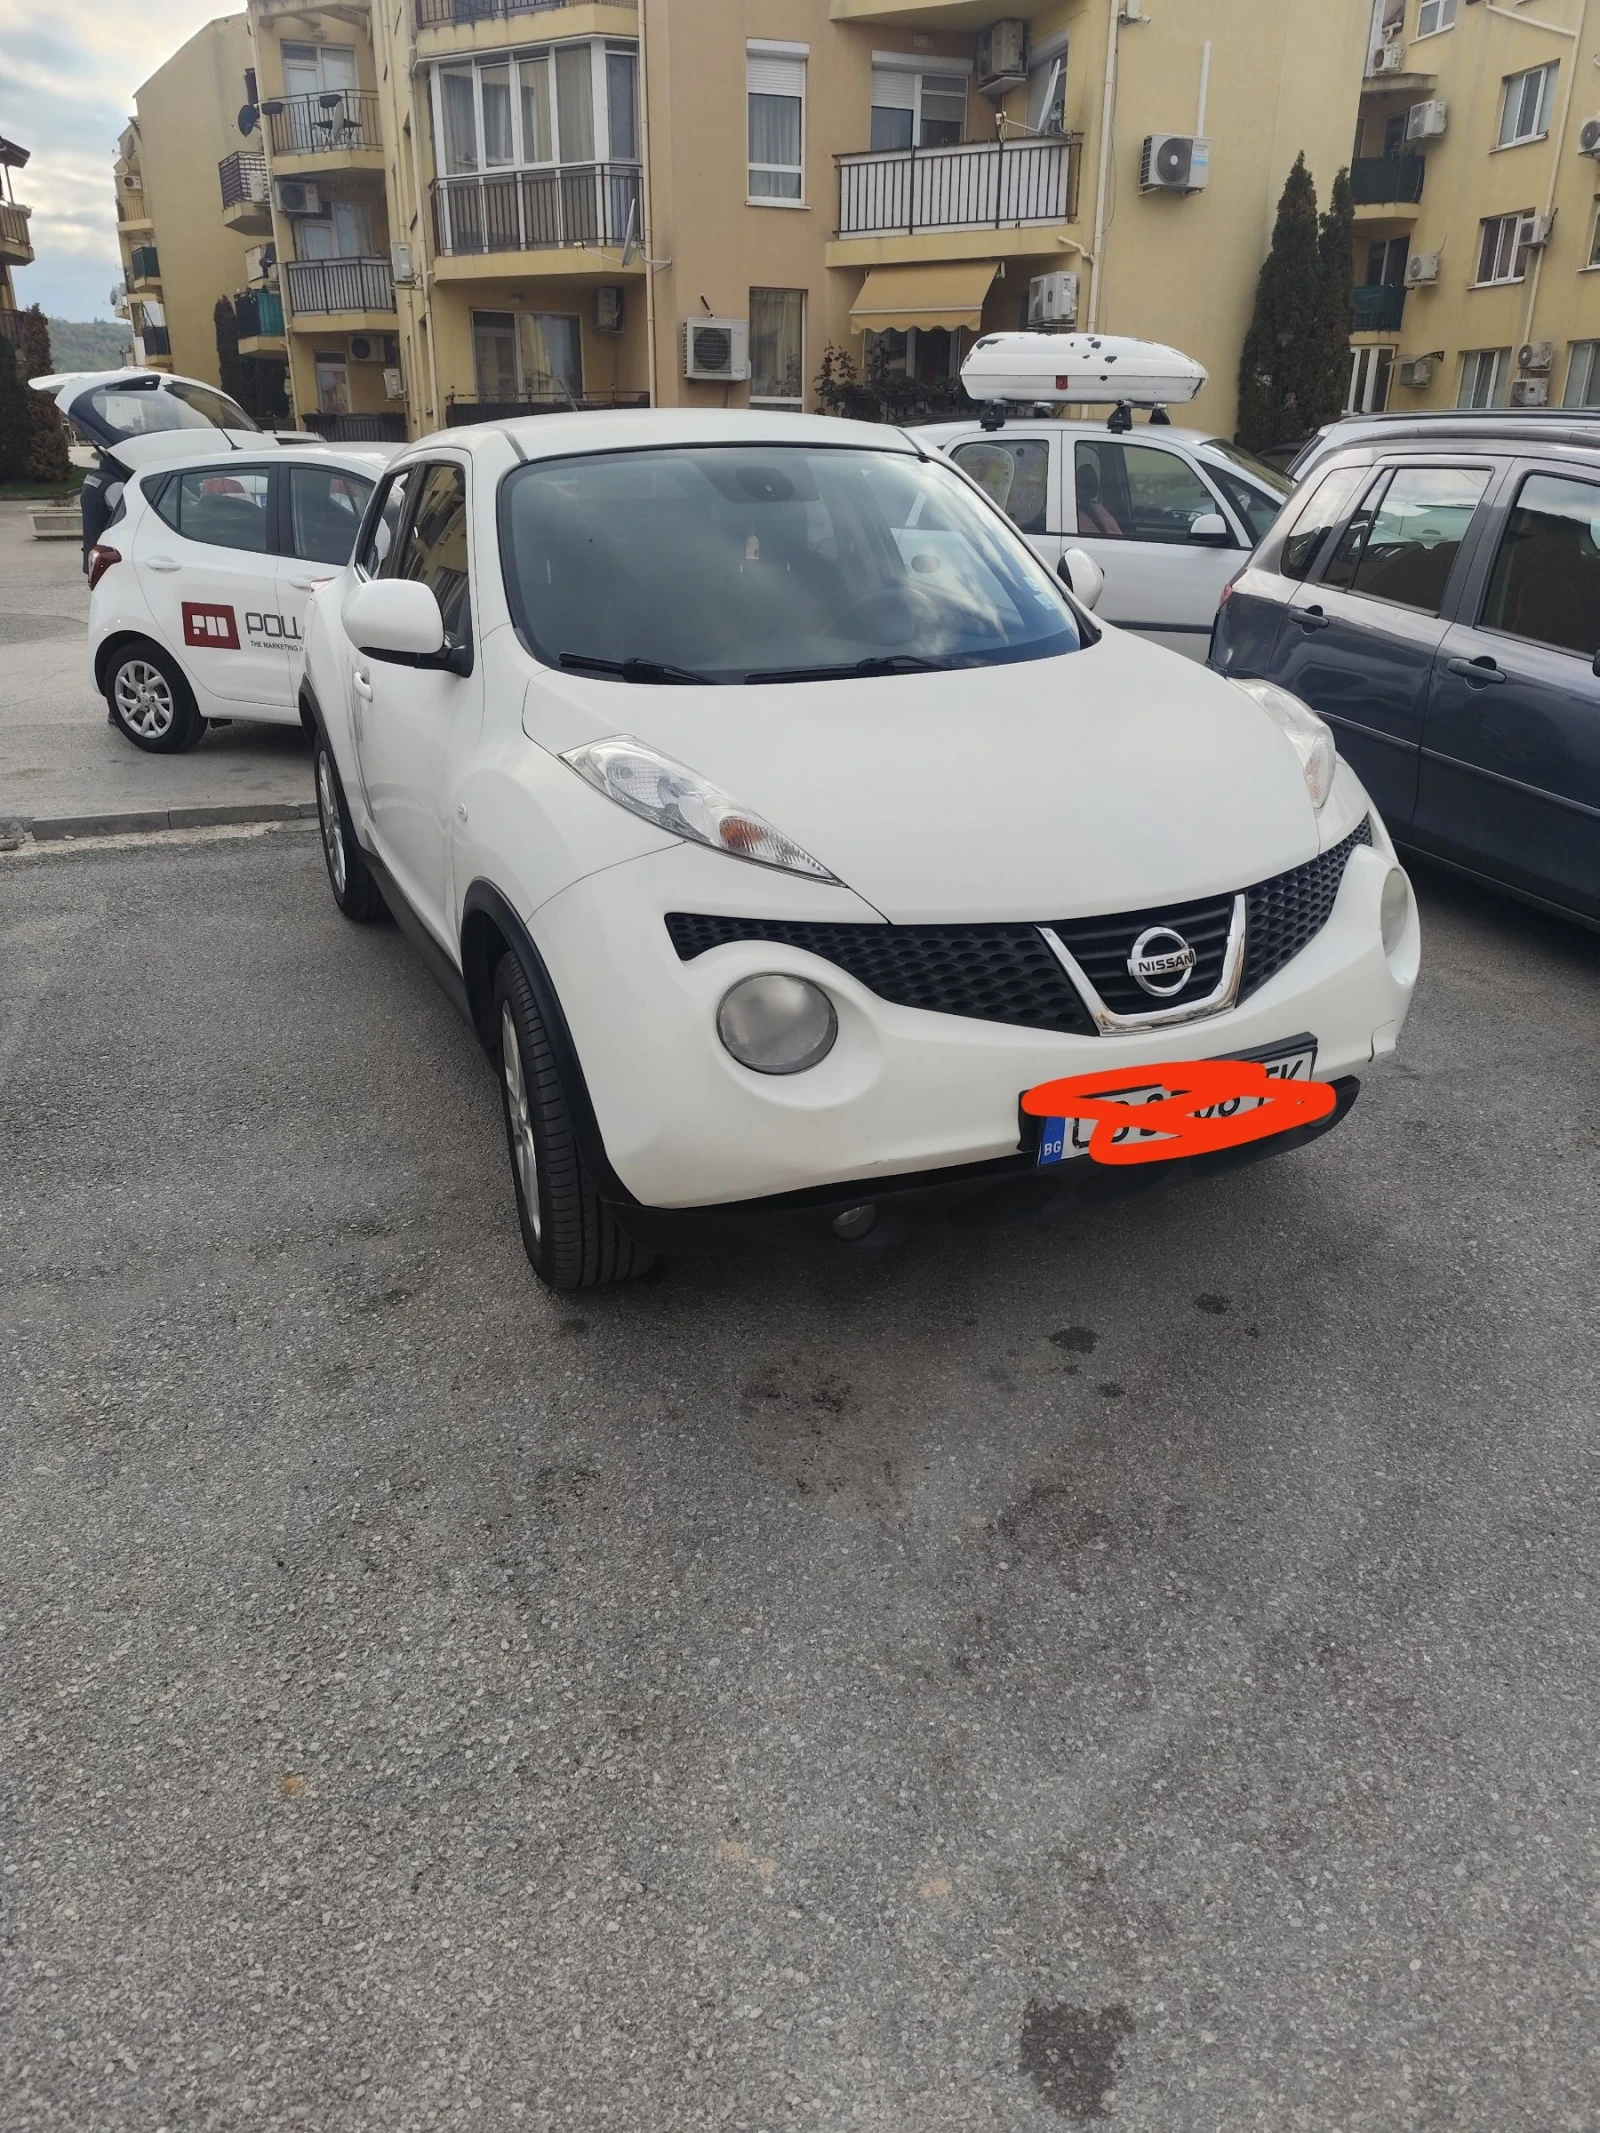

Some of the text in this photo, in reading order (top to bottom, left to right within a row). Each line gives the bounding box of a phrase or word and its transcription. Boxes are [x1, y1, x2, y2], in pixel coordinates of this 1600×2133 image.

[250, 640, 262, 648] THE
[263, 642, 298, 652] MARKETING
[1138, 950, 1194, 972] NISSAN
[1043, 1140, 1062, 1157] BG
